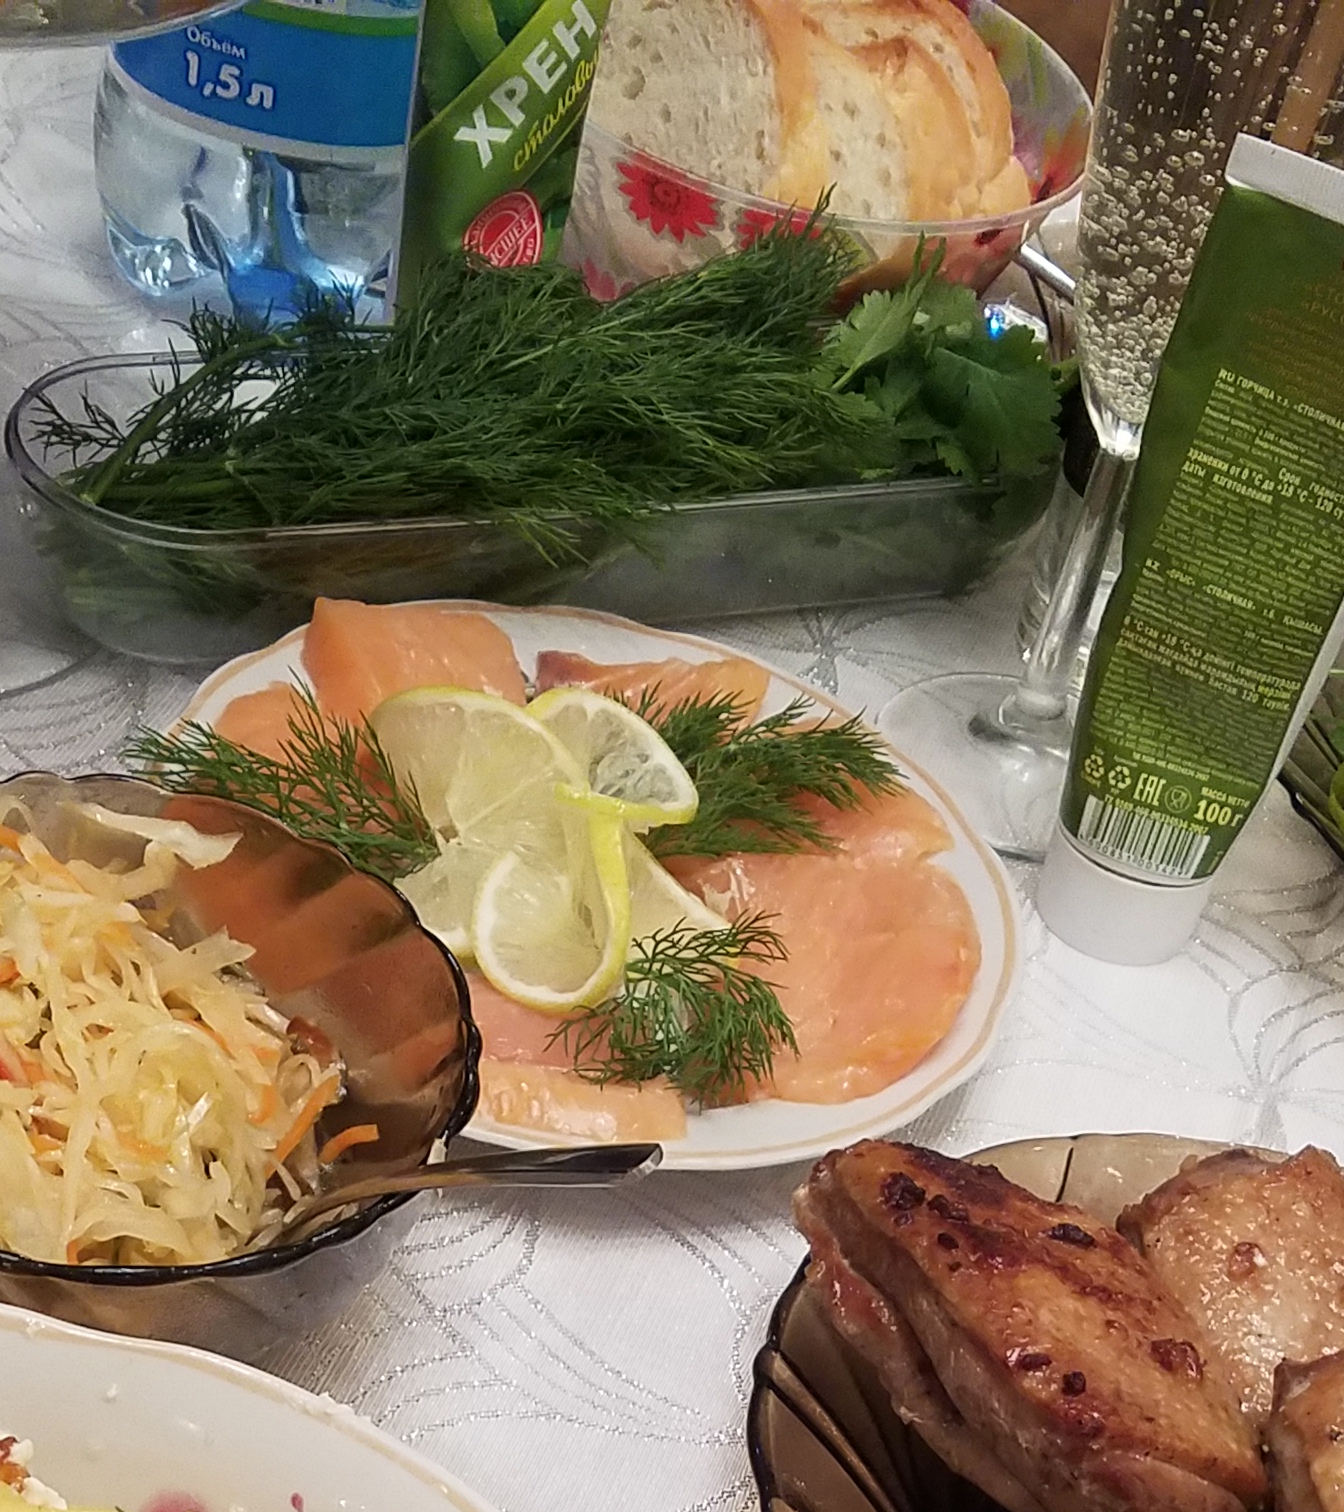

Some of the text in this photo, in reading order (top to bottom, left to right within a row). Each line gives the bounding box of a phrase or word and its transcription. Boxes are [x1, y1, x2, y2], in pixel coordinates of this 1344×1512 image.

[185, 50, 241, 99] 1,5
[453, 0, 596, 169] ХРЕН
[1193, 798, 1233, 827] 100
